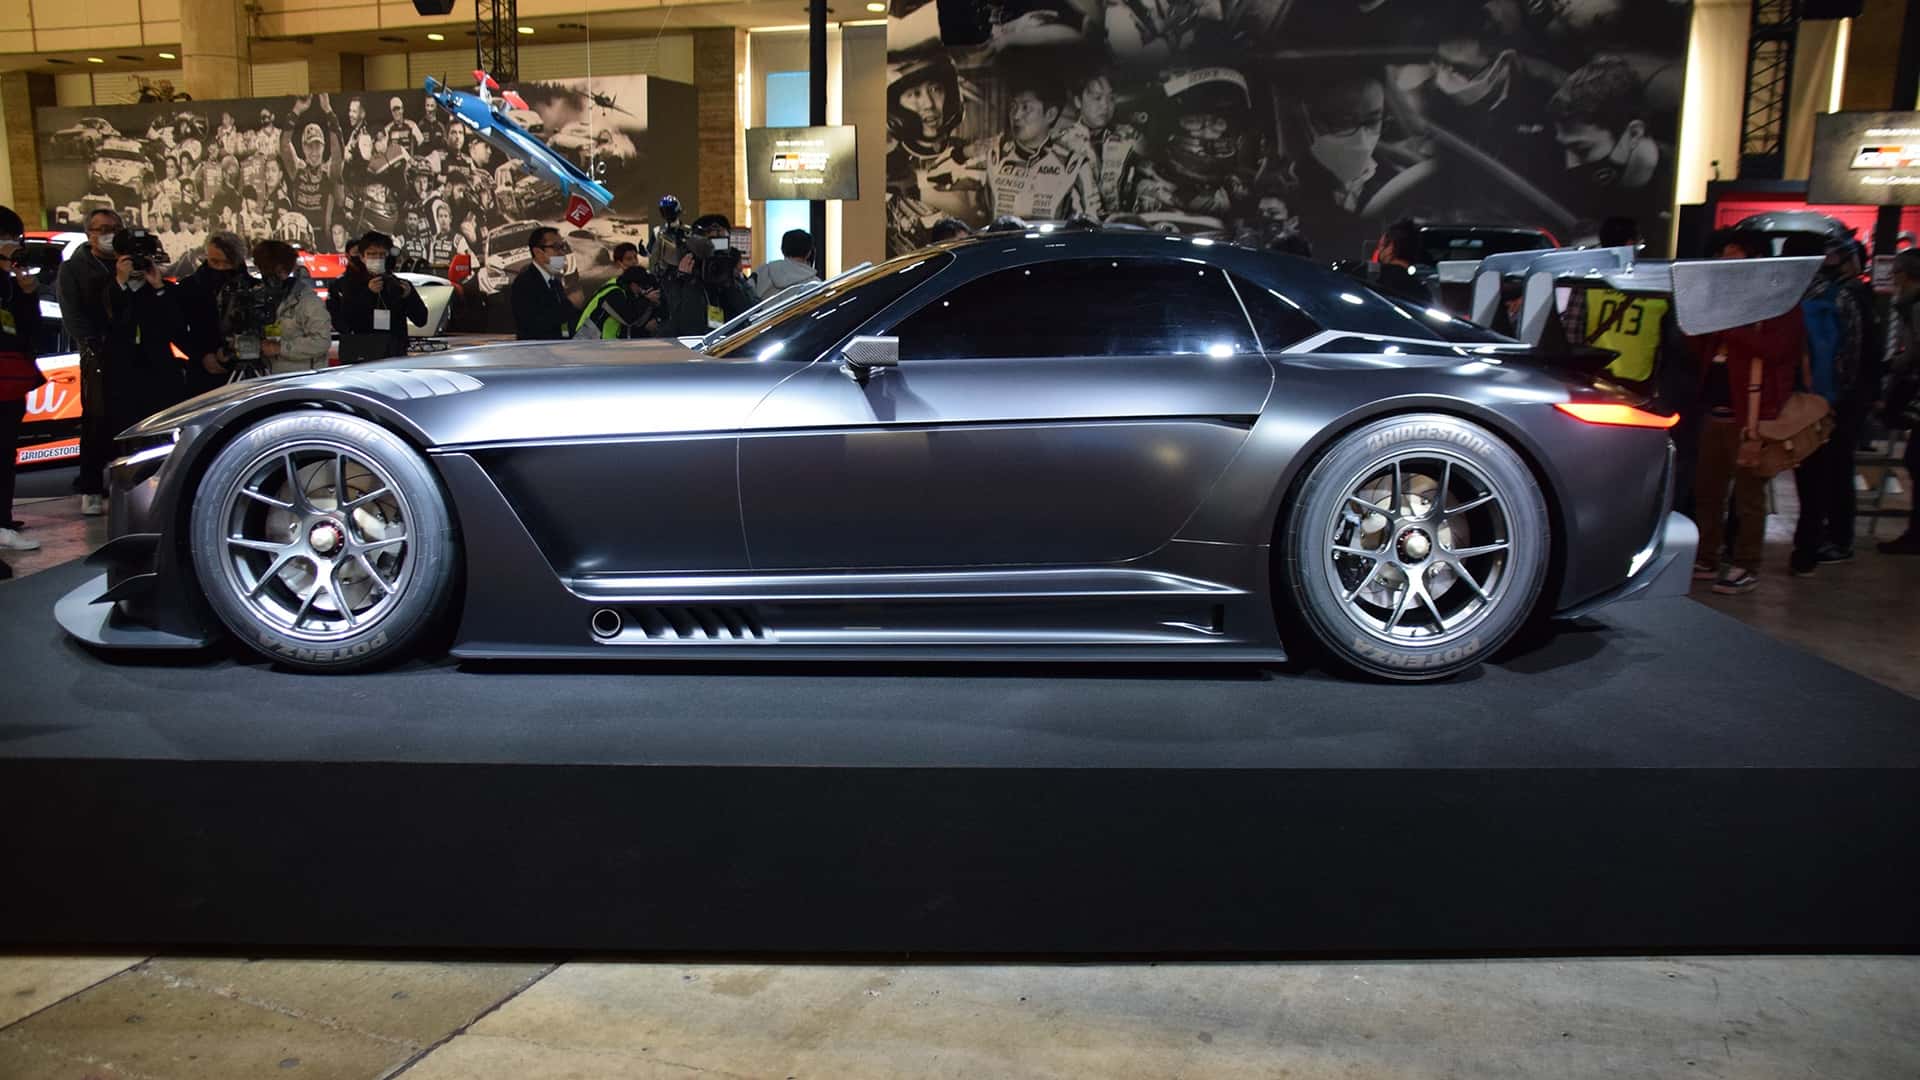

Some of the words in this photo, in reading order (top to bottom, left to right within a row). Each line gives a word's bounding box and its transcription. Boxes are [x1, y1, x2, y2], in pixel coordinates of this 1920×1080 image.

[251, 415, 380, 447] BRIDGESTONE
[1366, 424, 1494, 456] BRIDGESTONE
[21, 446, 80, 461] BRIDGESTONE
[258, 631, 389, 662] POTENZA
[1353, 637, 1480, 667] POTENZA
